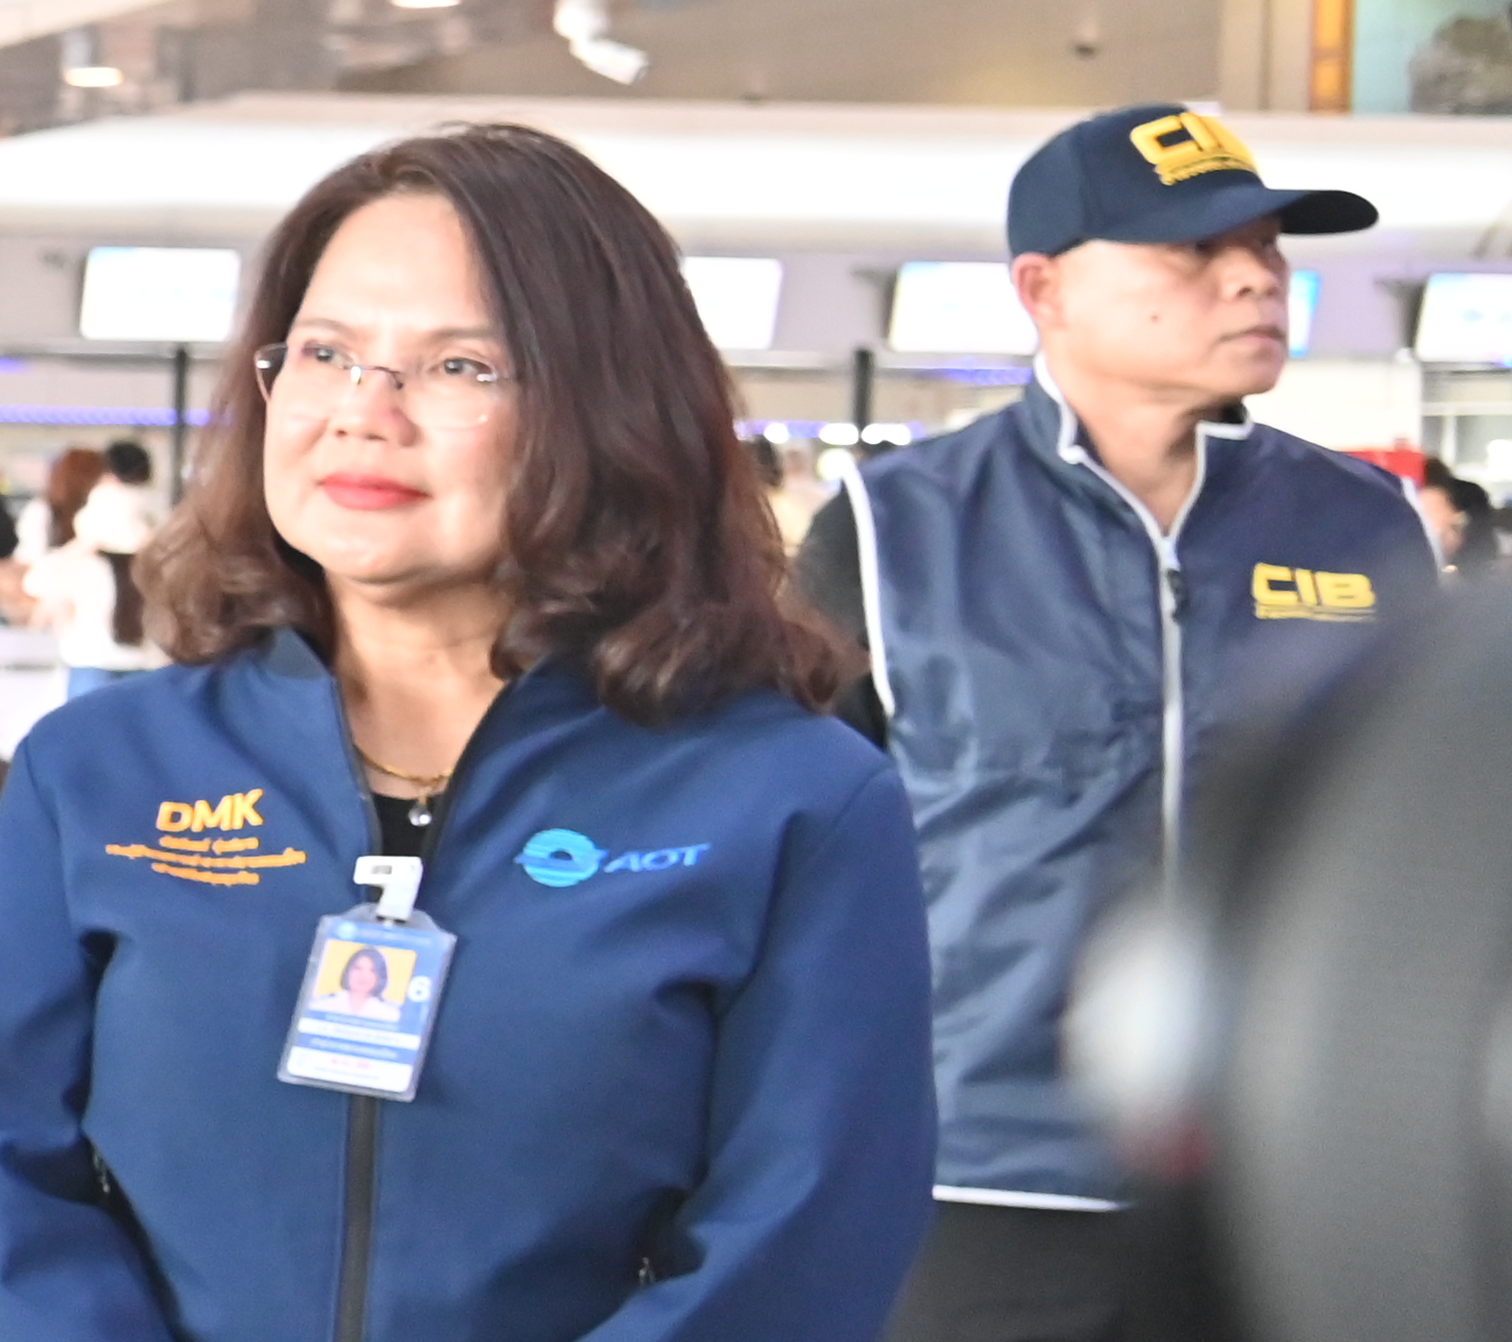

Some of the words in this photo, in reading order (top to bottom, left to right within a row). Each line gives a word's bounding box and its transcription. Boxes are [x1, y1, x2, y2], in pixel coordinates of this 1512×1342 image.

[1252, 562, 1376, 608] CIB
[155, 788, 264, 833] DMK
[603, 842, 712, 873] AOT
